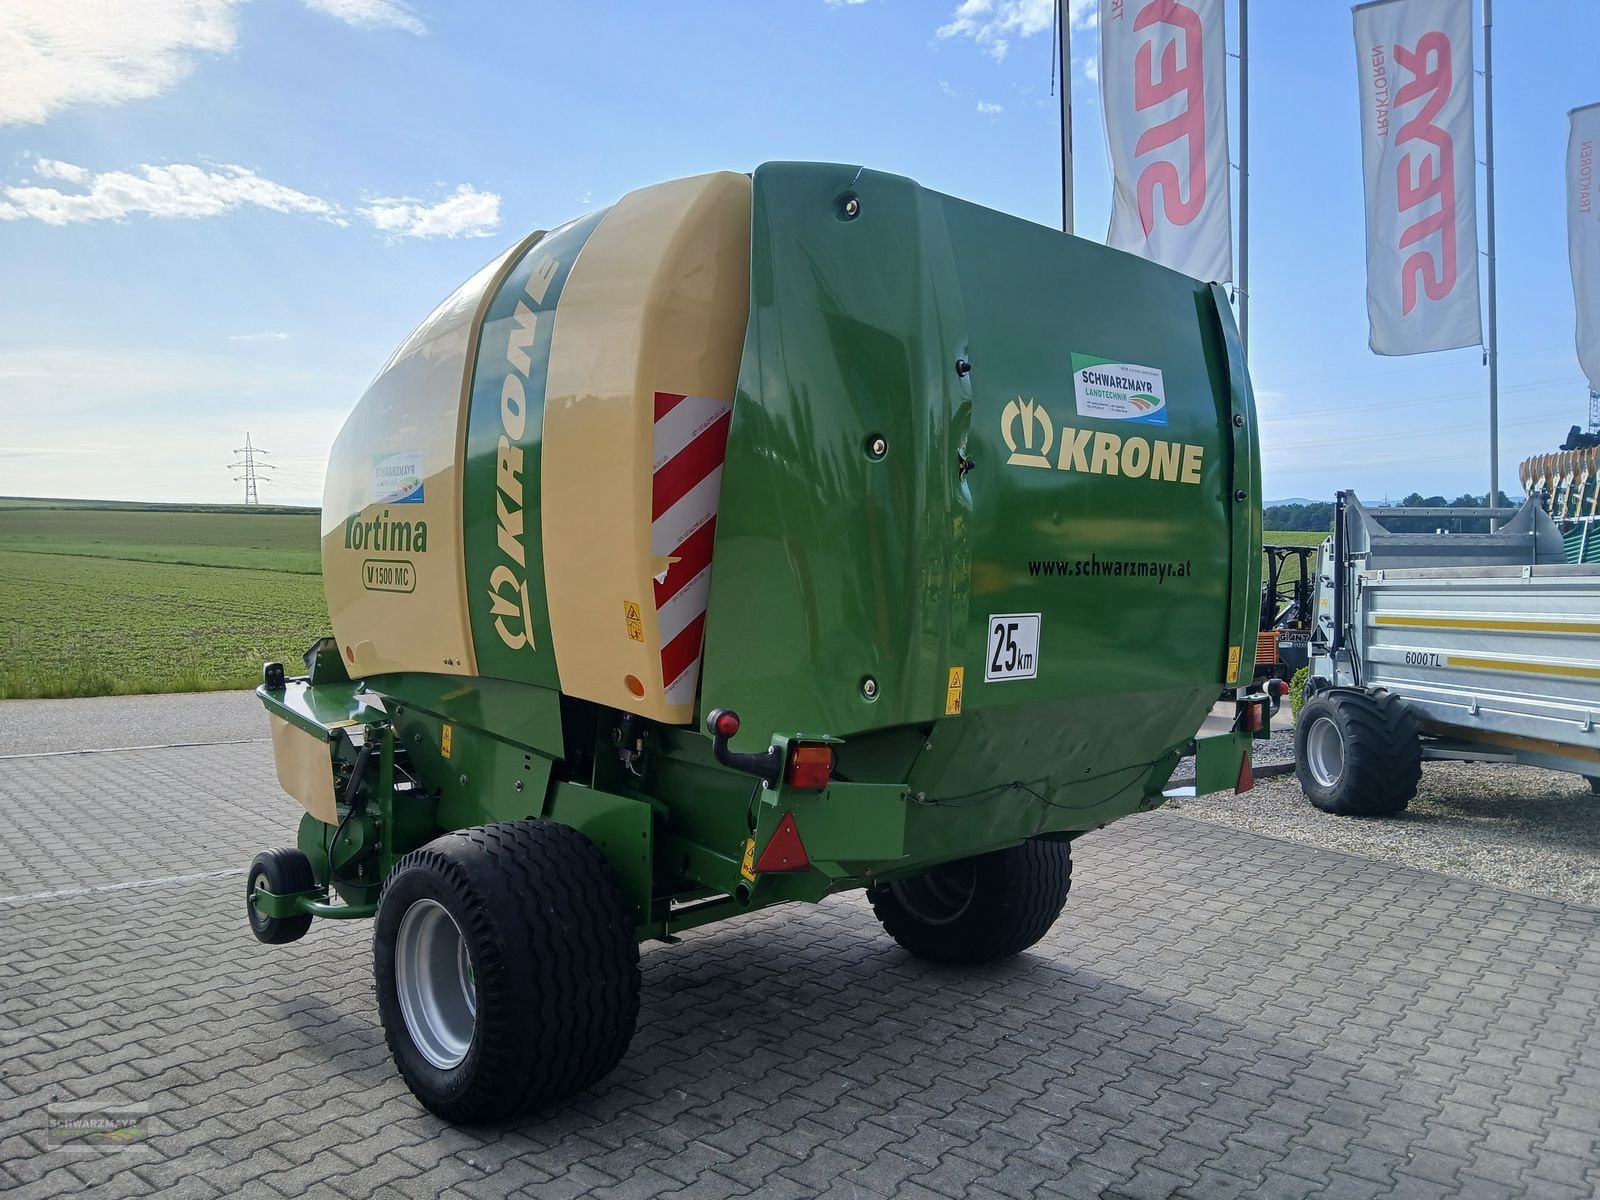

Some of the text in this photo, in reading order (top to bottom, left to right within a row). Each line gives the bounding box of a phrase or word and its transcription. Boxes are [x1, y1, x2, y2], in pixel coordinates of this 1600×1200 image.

[1082, 370, 1153, 393] SCHWARZMAYR
[1085, 387, 1128, 402] LANDTECHNIK
[497, 256, 560, 569] KRONE
[1057, 426, 1204, 485] KRONE
[367, 566, 409, 586] V 1500 MC
[1028, 553, 1191, 584] www.schwarzmayr.at
[991, 623, 1032, 672] 25 km
